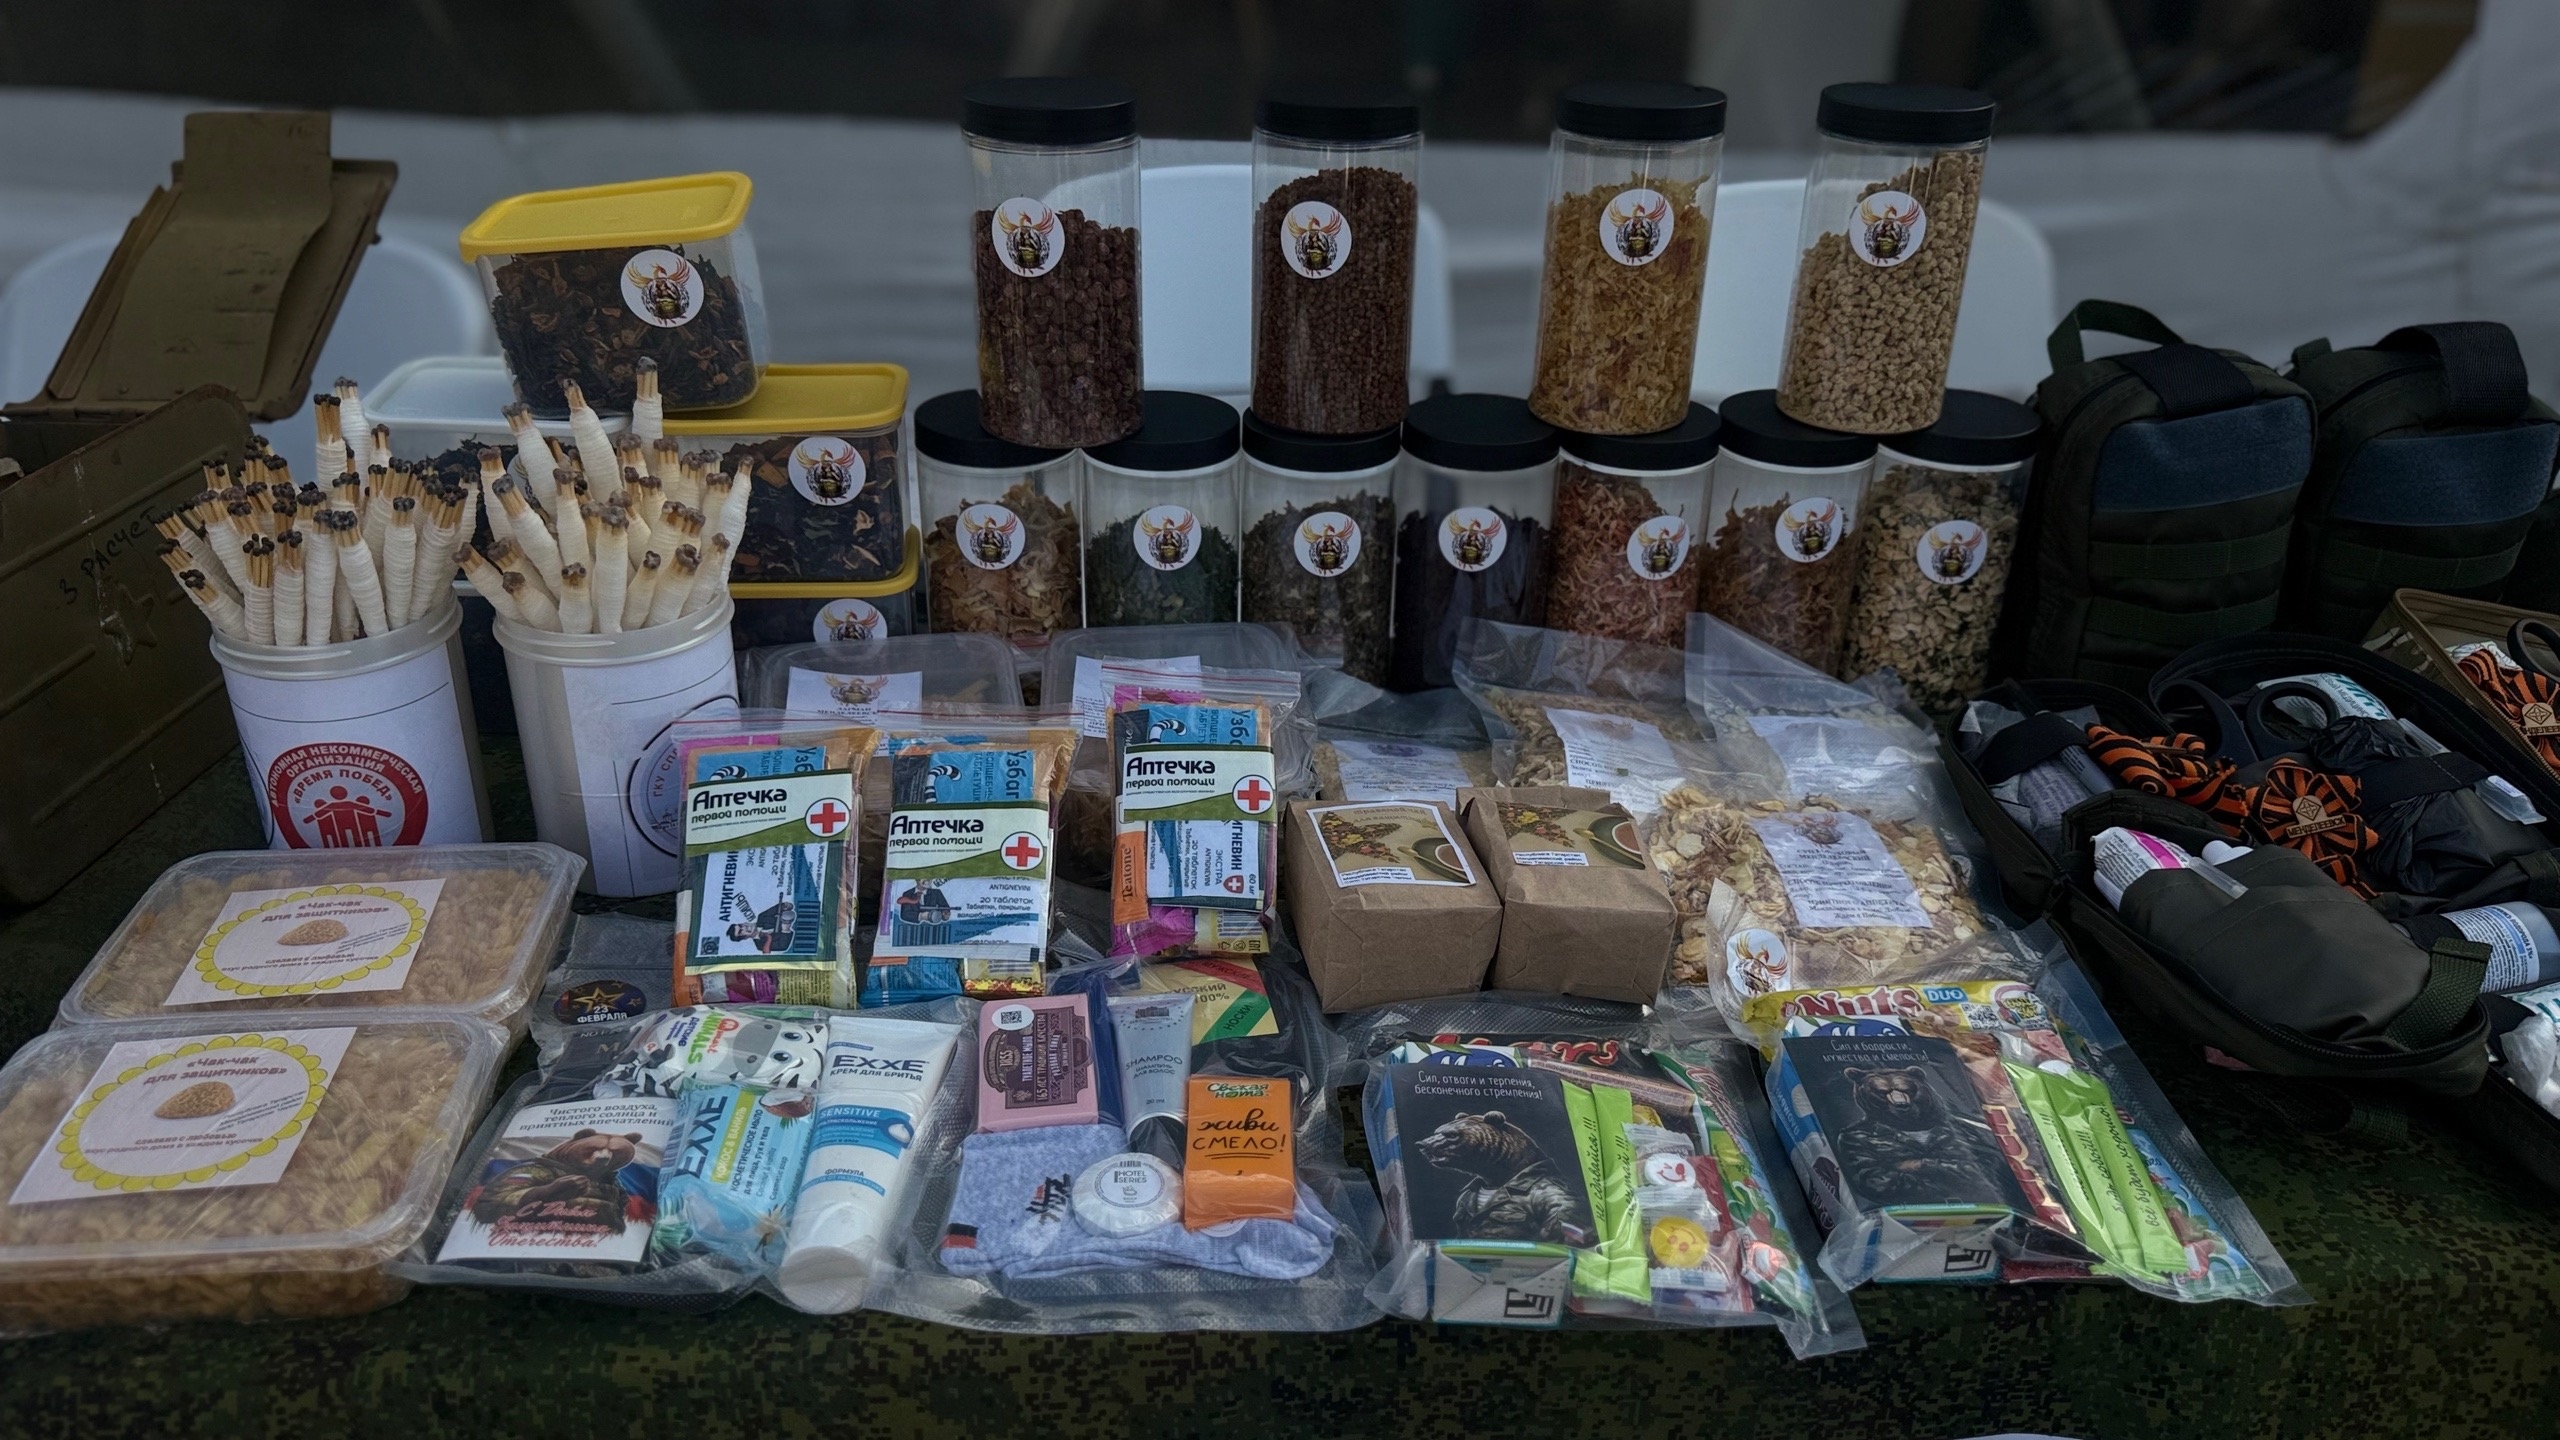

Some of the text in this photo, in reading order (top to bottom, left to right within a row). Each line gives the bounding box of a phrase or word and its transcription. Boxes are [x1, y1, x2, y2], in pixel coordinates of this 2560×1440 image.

[286, 754, 385, 778] ОРГАНИЗАЦИЯ
[1126, 757, 1216, 777] Аптечка
[270, 745, 424, 807] АВТОНОМНАЯ НЕКОММЕРЧЕСКАЯ
[1126, 777, 1215, 790] первой помощи
[692, 788, 788, 812] Аптечка
[691, 805, 787, 825] первой помощи
[890, 815, 984, 836] Аптечка
[889, 836, 983, 848] первой помощи
[1121, 848, 1135, 902] Teatone
[1215, 849, 1223, 885] ЭКСТРА
[994, 896, 1034, 905] таблеток
[1926, 988, 1965, 1002] DUO
[577, 1012, 628, 1024] ФЕВРАЛЯ
[593, 1004, 609, 1014] 23
[1223, 1004, 1253, 1031] НОСКИ
[1035, 1014, 1046, 1042] КАЧЕСТВА
[1830, 1039, 1852, 1051] Сил
[1853, 1043, 1861, 1051] и
[833, 1054, 926, 1073] EXXE
[999, 1050, 1013, 1067] 1855
[1022, 1035, 1033, 1082] ТУАЛЕТНОЕ МЫЛО
[1125, 1054, 1183, 1071] SHAMPOO
[1874, 1052, 1881, 1061] и
[1882, 1050, 1930, 1062] смелости!
[830, 1068, 858, 1076] КРЕМ
[884, 1071, 923, 1082] БРИТЬЯ
[1036, 1076, 1047, 1088] ЛЕТ
[1418, 1070, 1535, 1089] Сил, отваги и терпения,
[1036, 1088, 1048, 1101] 165
[1207, 1082, 1270, 1093] Свежая
[1414, 1084, 1543, 1101] бесконечного стремления!
[544, 1112, 596, 1122] теплого
[599, 1111, 645, 1119] солнца
[550, 1103, 658, 1115] Чистого воздуха,
[819, 1107, 881, 1119] SENSITIVE
[520, 1117, 674, 1131] приятных впечатлений
[1197, 1108, 1279, 1132] живи
[672, 1096, 728, 1179] EXXE
[715, 1147, 734, 1179] КОКОС
[727, 1106, 748, 1140] ВАНИЛЬ
[1192, 1133, 1286, 1153] СМЕЛО!
[729, 1109, 764, 1192] КОСМЕТИЧЕСКОЕ МЫЛО
[743, 1181, 754, 1195] для
[754, 1146, 765, 1159] рук
[760, 1126, 770, 1140] тела
[1586, 1133, 1603, 1200] сдавайся
[824, 1168, 864, 1177] ФОРМУЛА
[1118, 1176, 1147, 1184] SERIES
[2126, 1161, 2151, 1203] будет
